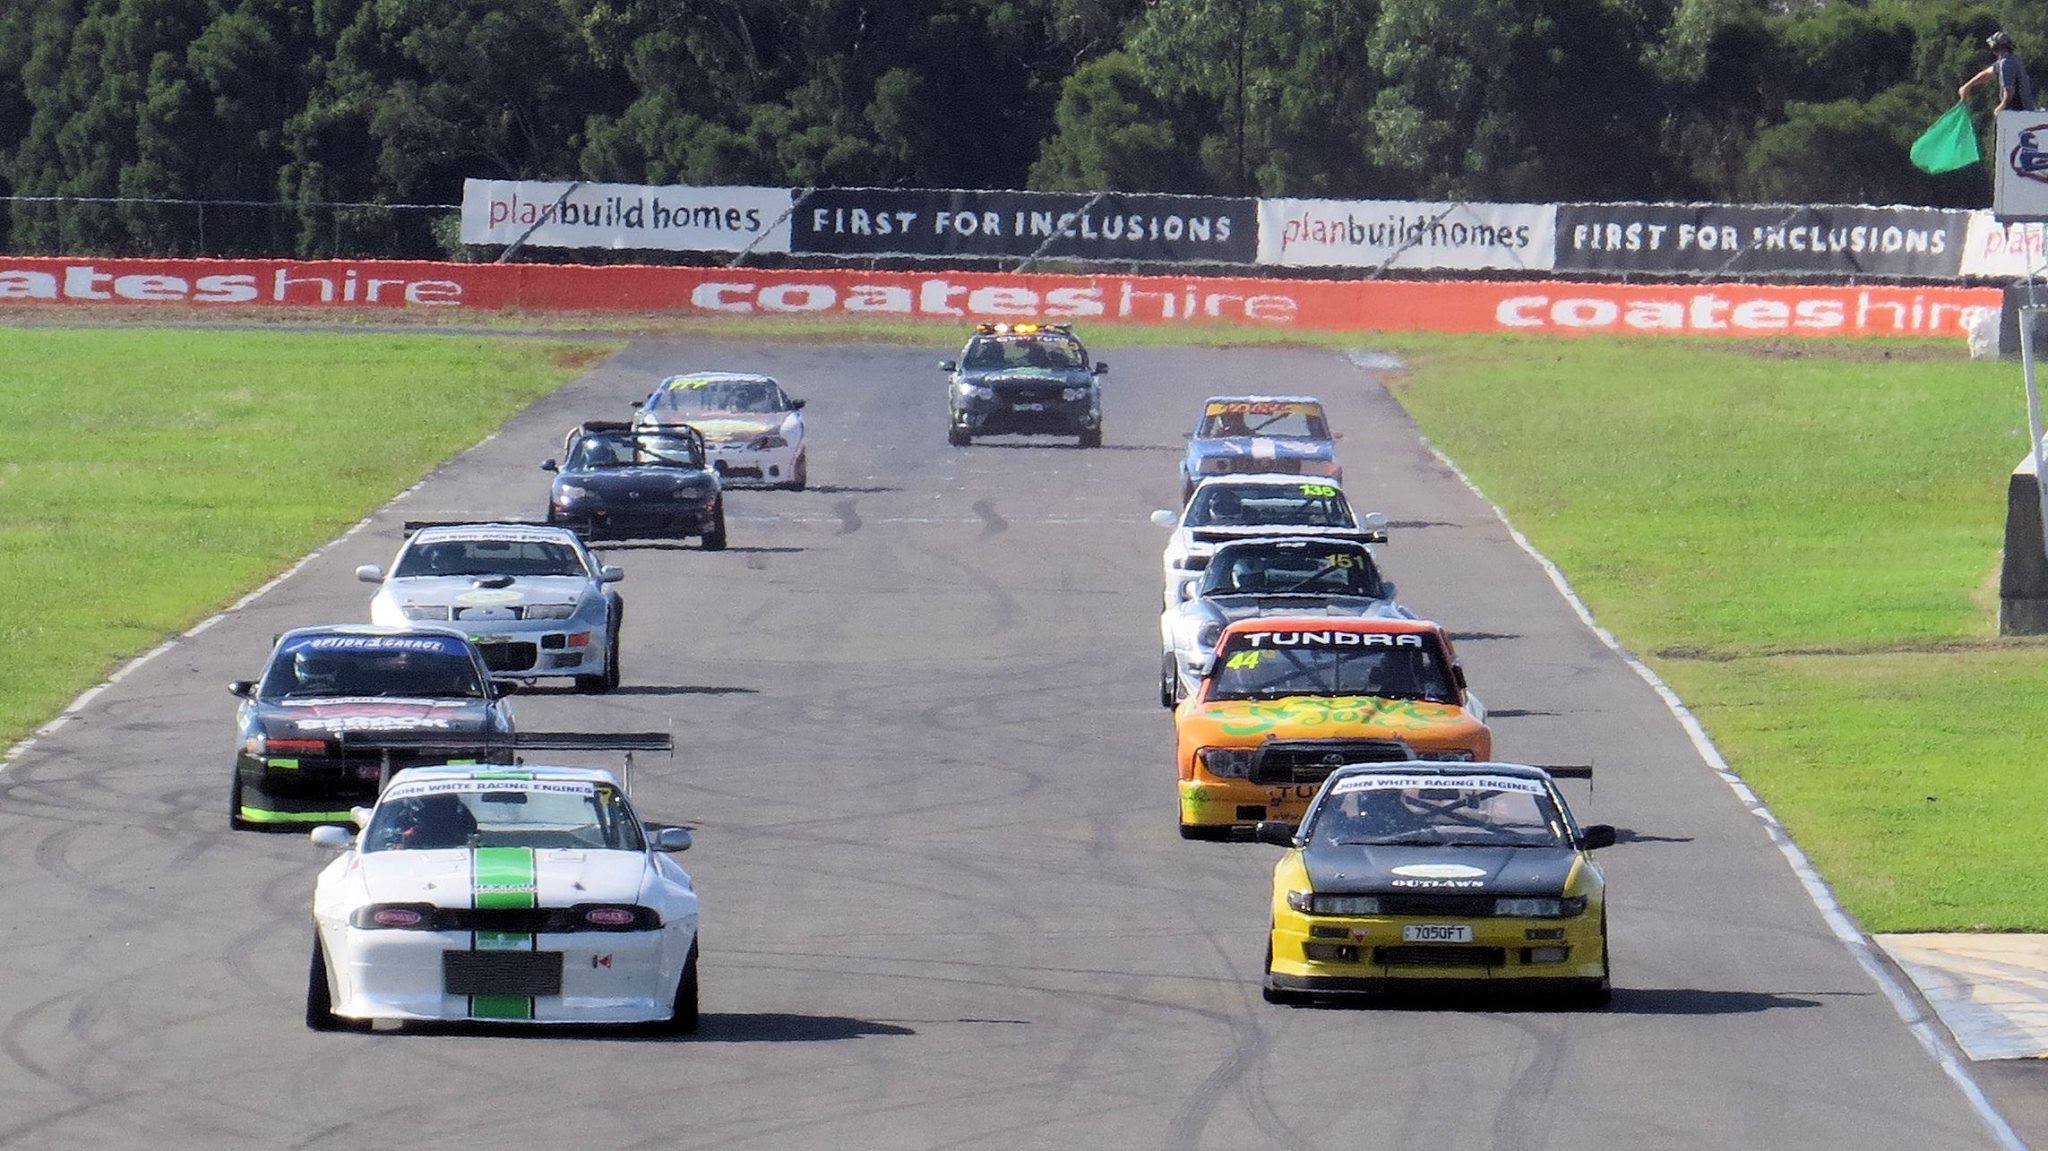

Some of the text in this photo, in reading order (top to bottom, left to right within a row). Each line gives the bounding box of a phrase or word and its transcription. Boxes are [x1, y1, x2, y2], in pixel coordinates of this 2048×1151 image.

[812, 208, 1232, 242] FIRST FOR INCLUSIONS
[1573, 222, 1947, 254] FIRST FOR INCLUSIONS
[273, 268, 463, 306] hire
[691, 279, 1298, 322] coates hire
[1495, 293, 1844, 331] coates
[1243, 631, 1423, 648] TUNDRA
[1226, 651, 1261, 671] 44
[389, 782, 593, 797] JOHN WHITE RACING ENGINES
[1340, 778, 1538, 792] JOHN WHITE RACING ENGINES
